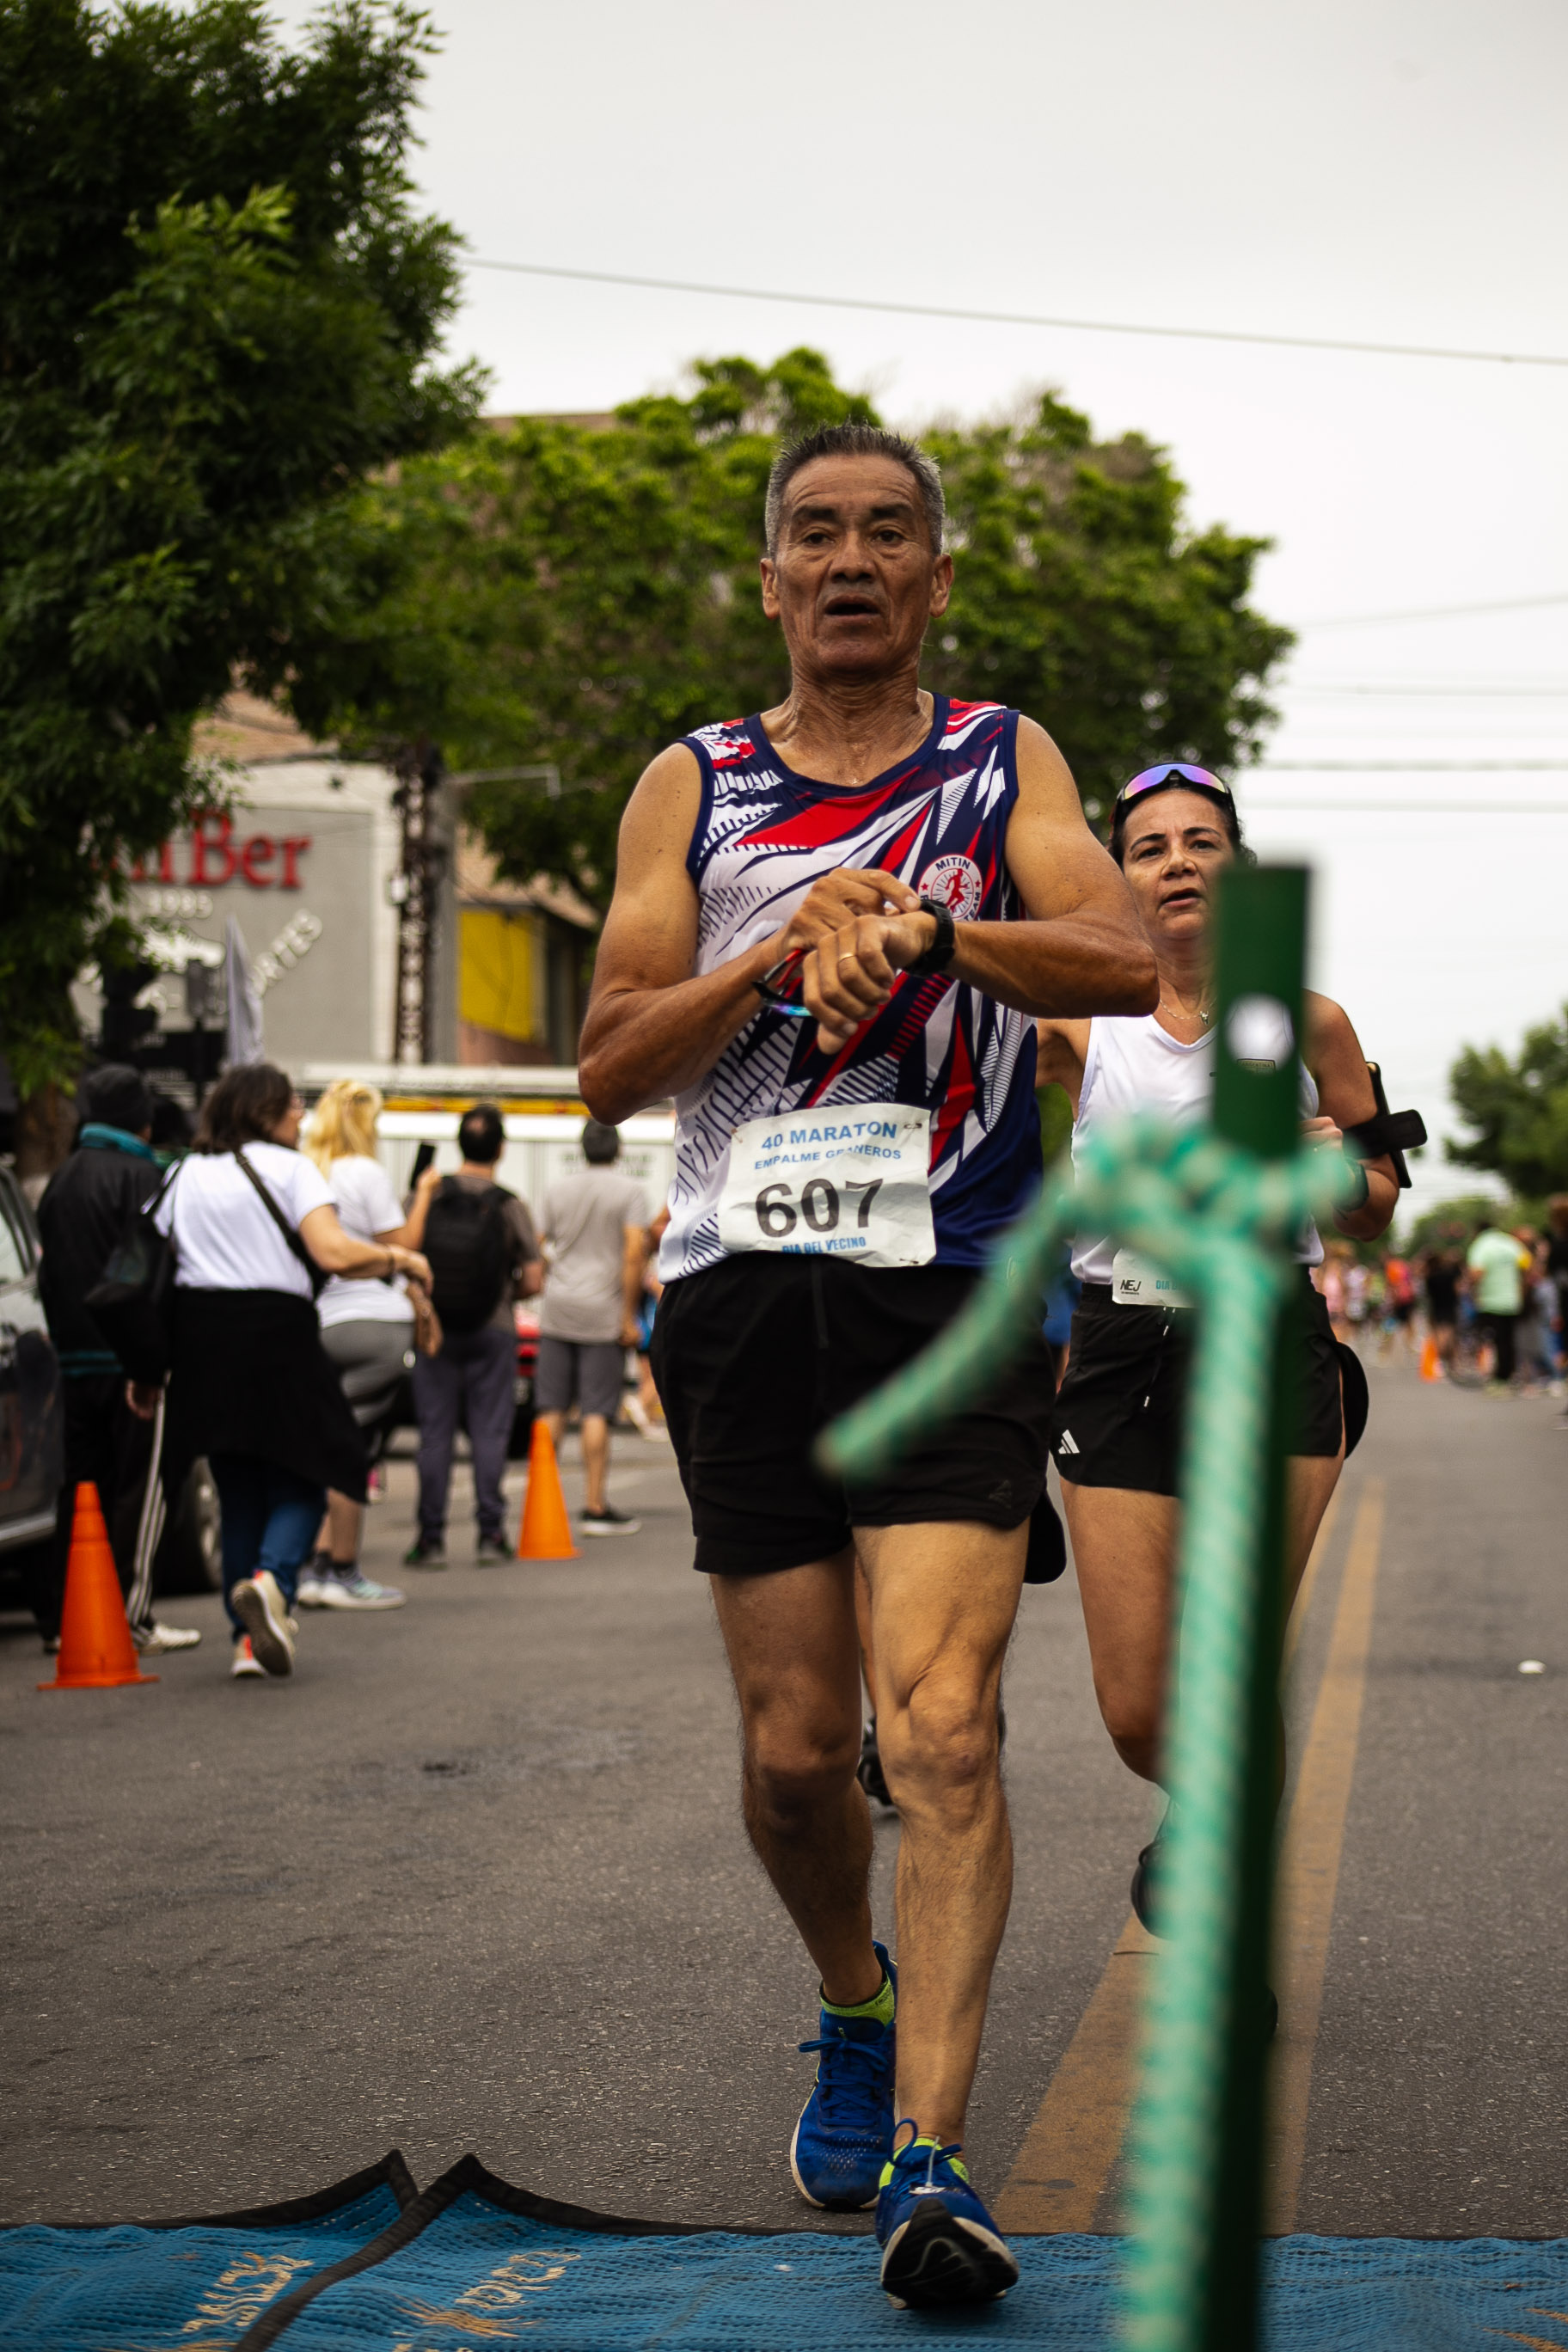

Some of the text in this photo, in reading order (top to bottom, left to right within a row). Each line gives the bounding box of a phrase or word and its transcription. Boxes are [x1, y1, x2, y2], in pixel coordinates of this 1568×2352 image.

[935, 857, 971, 871] MITIN
[964, 891, 981, 922] TEAM
[761, 1121, 897, 1150] 40 MARATON
[754, 1151, 821, 1170] EMPALME
[755, 1178, 884, 1238] 607
[825, 1235, 867, 1251] VECINO
[1120, 1279, 1142, 1291] NEJ
